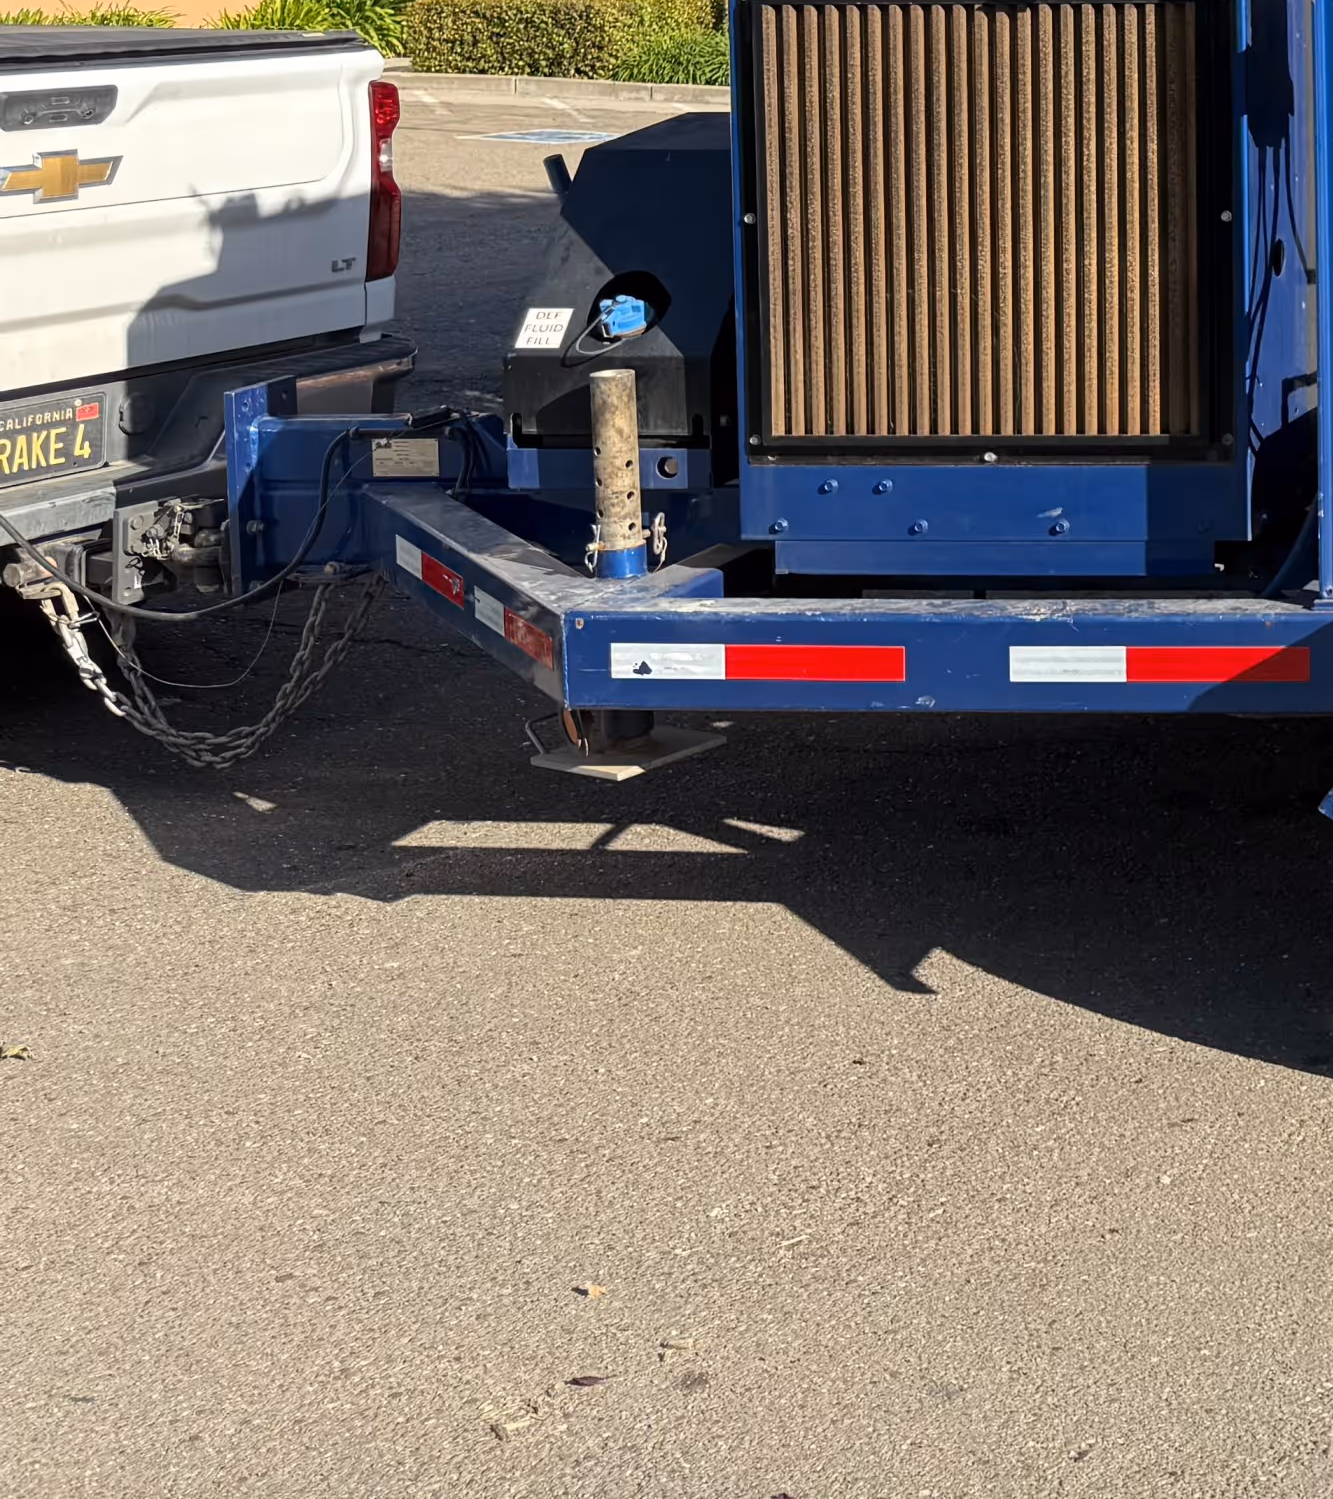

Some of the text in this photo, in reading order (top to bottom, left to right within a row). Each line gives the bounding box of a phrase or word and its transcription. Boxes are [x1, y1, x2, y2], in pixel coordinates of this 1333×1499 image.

[332, 257, 357, 272] LT
[536, 311, 562, 319] DEF
[525, 324, 563, 333] FLUID
[526, 337, 549, 345] FILL
[74, 423, 91, 458] 4
